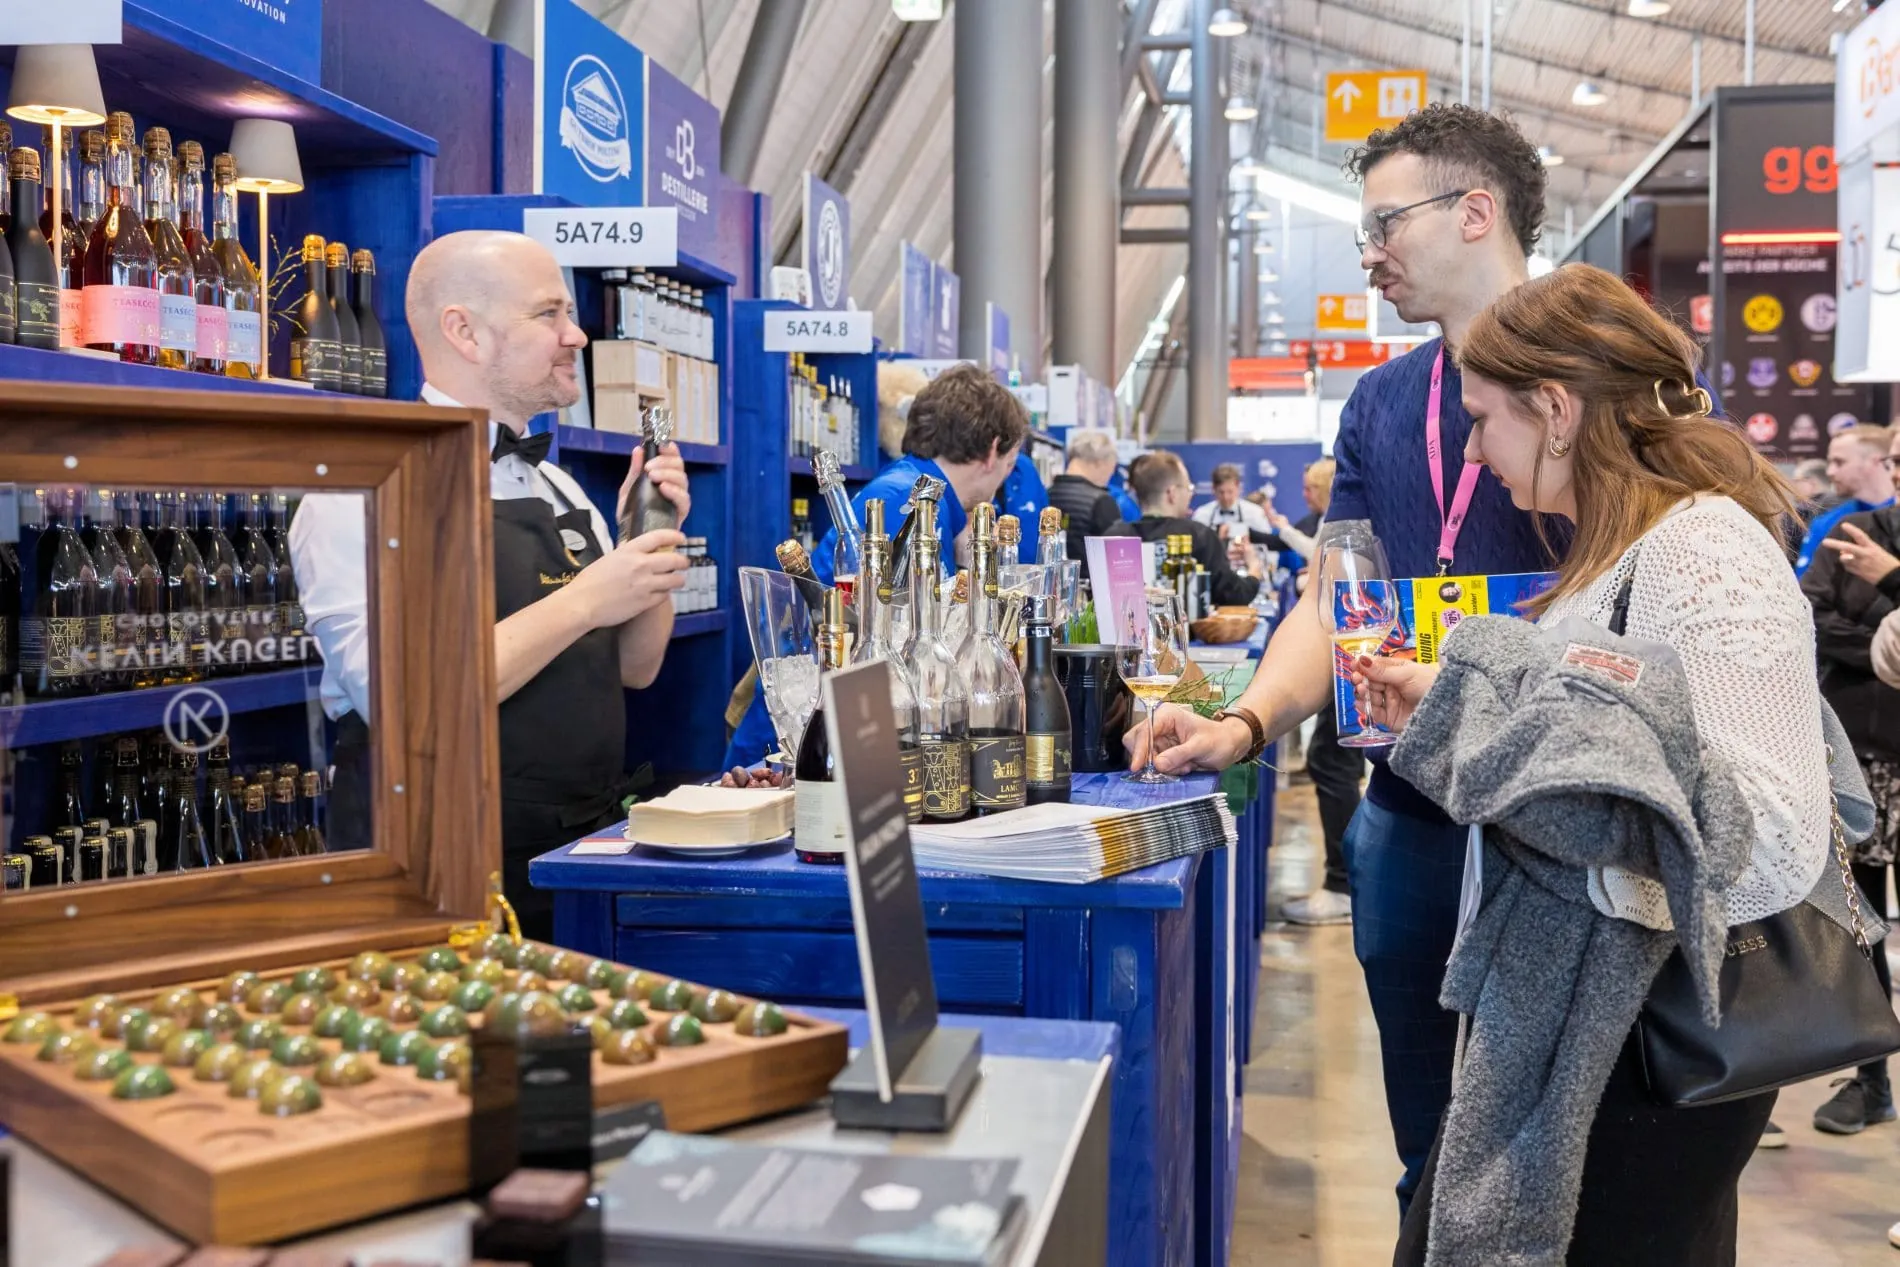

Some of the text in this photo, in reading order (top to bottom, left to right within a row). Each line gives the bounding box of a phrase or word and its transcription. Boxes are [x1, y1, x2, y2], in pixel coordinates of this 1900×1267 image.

[237, 0, 287, 24] OVATION
[661, 170, 709, 215] DESTILLERIE
[555, 221, 644, 246] 5A74.9
[786, 321, 849, 337] 5A74.8
